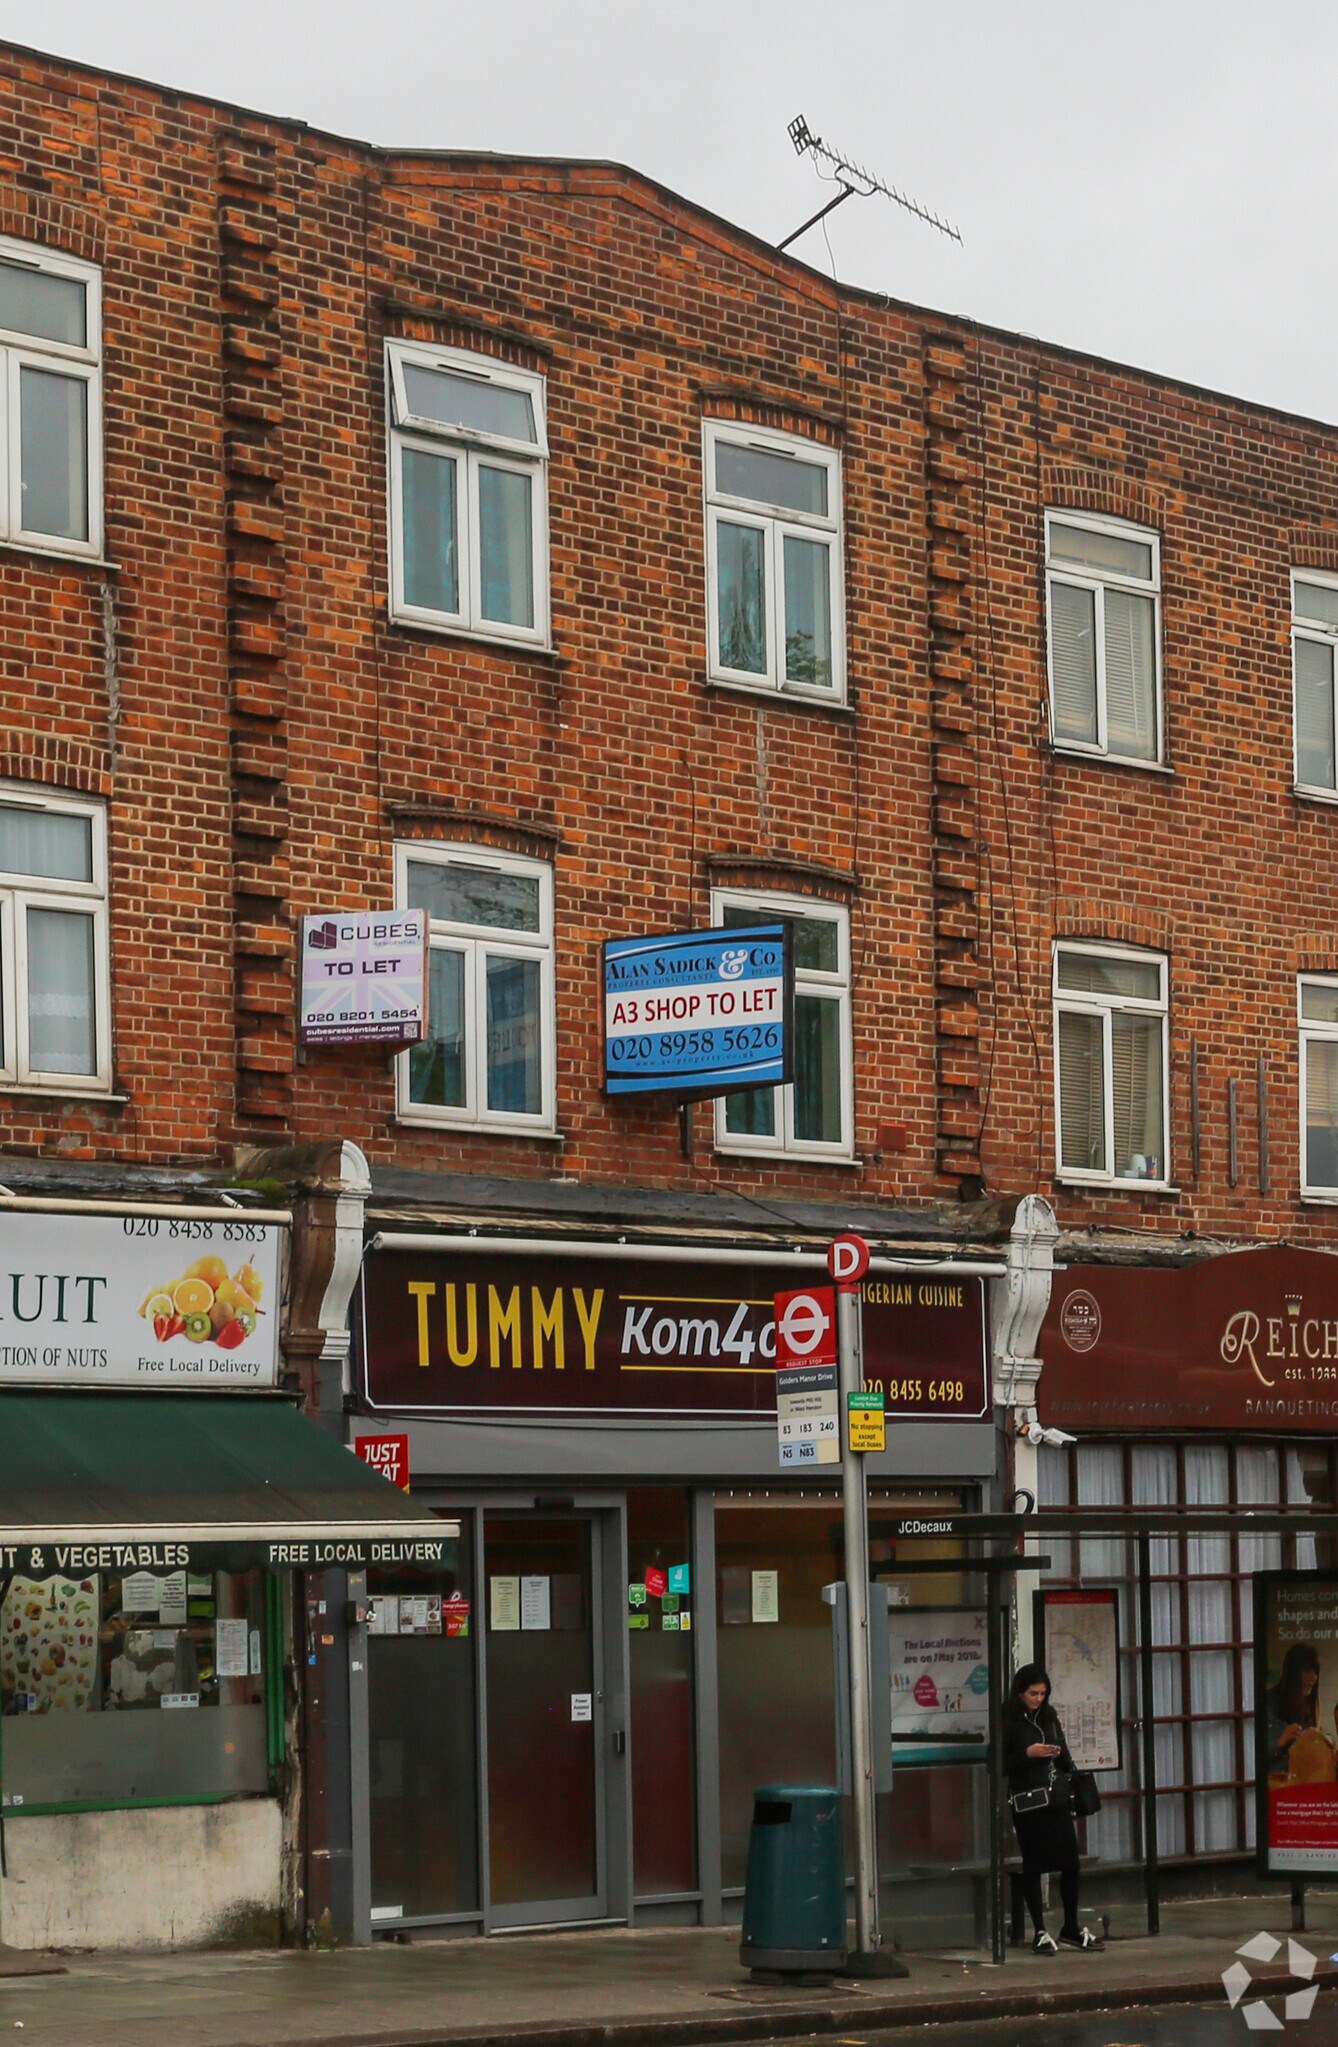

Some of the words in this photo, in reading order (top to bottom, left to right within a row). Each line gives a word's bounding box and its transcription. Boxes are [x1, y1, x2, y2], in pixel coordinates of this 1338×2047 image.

[341, 923, 418, 941] CUBES
[324, 962, 354, 976] TO
[362, 959, 402, 975] LET
[607, 962, 651, 981] ALAN
[654, 956, 717, 976] SADICK
[718, 949, 748, 980] &
[607, 978, 650, 989] PROPERTY
[653, 973, 714, 985] CONSULTANTS
[307, 1013, 335, 1023] 020
[340, 1011, 375, 1021] 8201
[381, 1008, 418, 1019] 5454
[612, 1001, 639, 1025] A3
[645, 996, 700, 1021] SHOP
[706, 992, 735, 1015] TO
[742, 988, 777, 1013] LET
[306, 1024, 400, 1036] cubesresidential.com
[611, 1036, 653, 1061] 020
[660, 1031, 714, 1057] 8958
[723, 1025, 778, 1052] 5626
[123, 1218, 159, 1237] 020
[169, 1220, 213, 1240] 8458
[223, 1223, 266, 1242] 8583
[834, 1242, 860, 1277] D
[0, 1273, 107, 1324] UIT
[862, 1283, 912, 1305] IGERIAN
[918, 1285, 964, 1307] CUISINE
[408, 1281, 605, 1370] TUMMY
[0, 1346, 37, 1366] TION
[43, 1347, 61, 1367] OF
[67, 1348, 108, 1368] NUTS
[137, 1357, 164, 1371] Free
[170, 1358, 203, 1372] Local
[208, 1358, 261, 1377] Delivery
[779, 1376, 799, 1385] Golders
[799, 1375, 817, 1383] Manor
[818, 1373, 833, 1381] Drive
[890, 1380, 922, 1400] 8455
[928, 1381, 964, 1401] 6498
[783, 1425, 791, 1434] 83
[800, 1423, 812, 1433] 183
[820, 1421, 834, 1431] 240
[860, 1423, 883, 1431] stopping
[364, 1442, 401, 1464] JUST
[783, 1449, 793, 1459] N5
[799, 1447, 815, 1457] N83
[899, 1520, 952, 1534] JCDecaux
[30, 1547, 45, 1569] &
[55, 1545, 190, 1569] VEGETABLES
[269, 1545, 309, 1562] FREE
[315, 1544, 366, 1562] LOCAL
[371, 1543, 443, 1561] DELIVERY
[1278, 1607, 1314, 1625] shapes
[1317, 1606, 1338, 1620] and
[1278, 1626, 1294, 1640] So
[1296, 1626, 1311, 1640] do
[1313, 1630, 1332, 1639] our
[904, 1640, 918, 1650] The
[920, 1638, 944, 1649] Local
[920, 1654, 932, 1663] on
